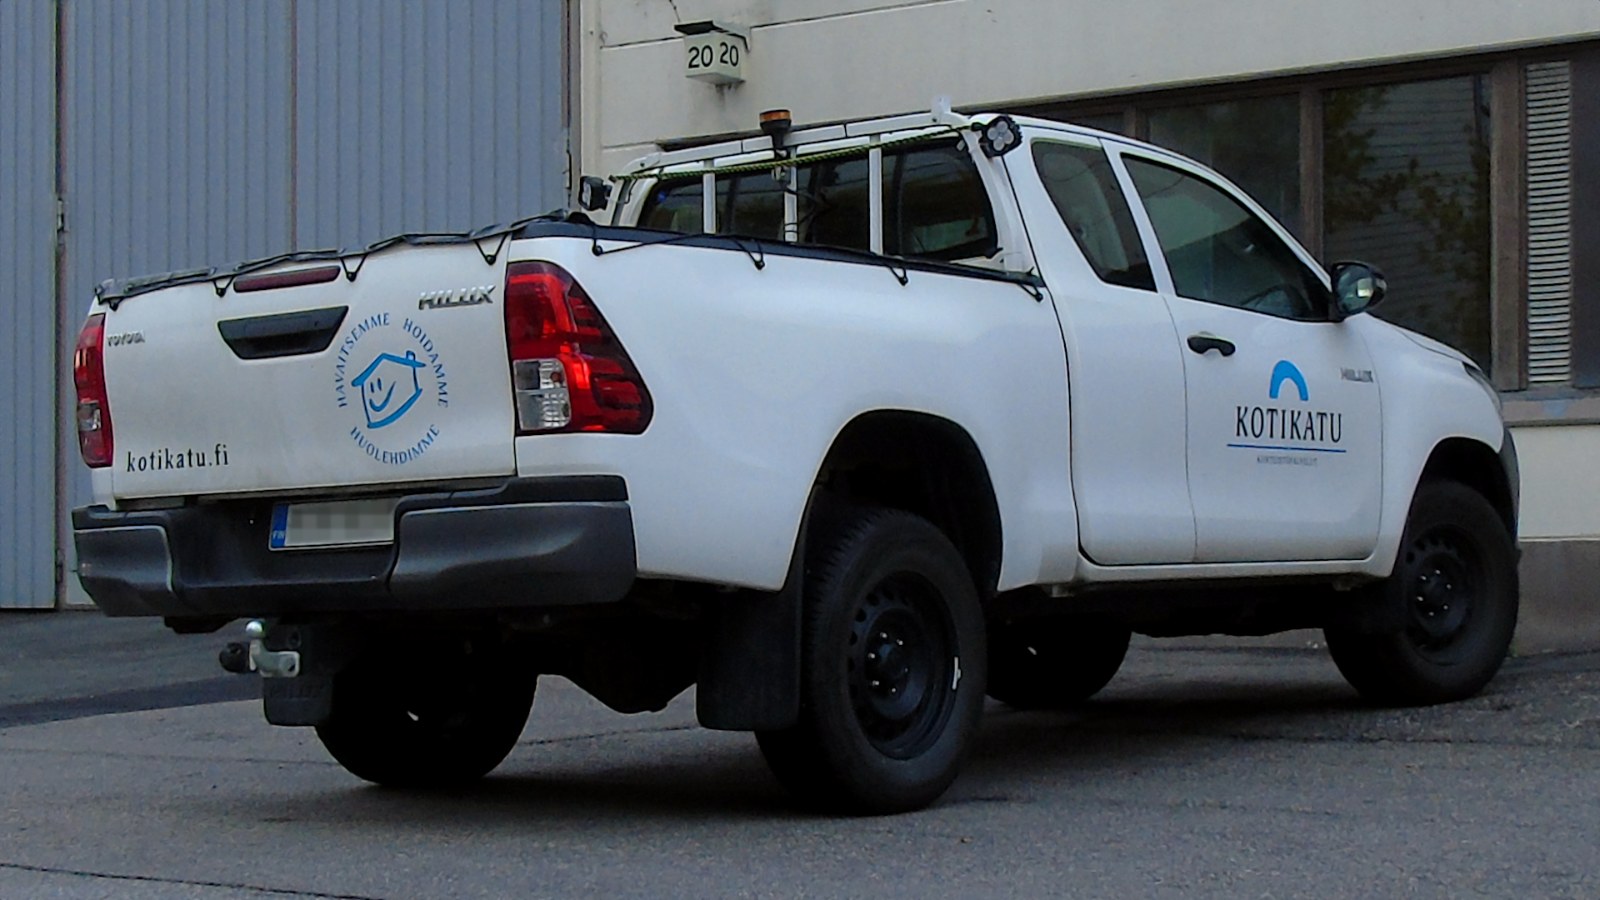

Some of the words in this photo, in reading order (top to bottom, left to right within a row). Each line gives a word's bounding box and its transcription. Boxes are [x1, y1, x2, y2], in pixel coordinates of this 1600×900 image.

[688, 45, 713, 69] 20
[719, 41, 739, 67] 20
[418, 284, 496, 310] HILUX
[107, 331, 146, 347] TOYOTA
[335, 312, 390, 408] HAVAITSEMME
[402, 317, 449, 409] HOIDAMME
[1235, 405, 1343, 443] KOTIKATU
[127, 443, 229, 472] kotikatu.fi
[350, 423, 440, 465] HUOLEHDIMME
